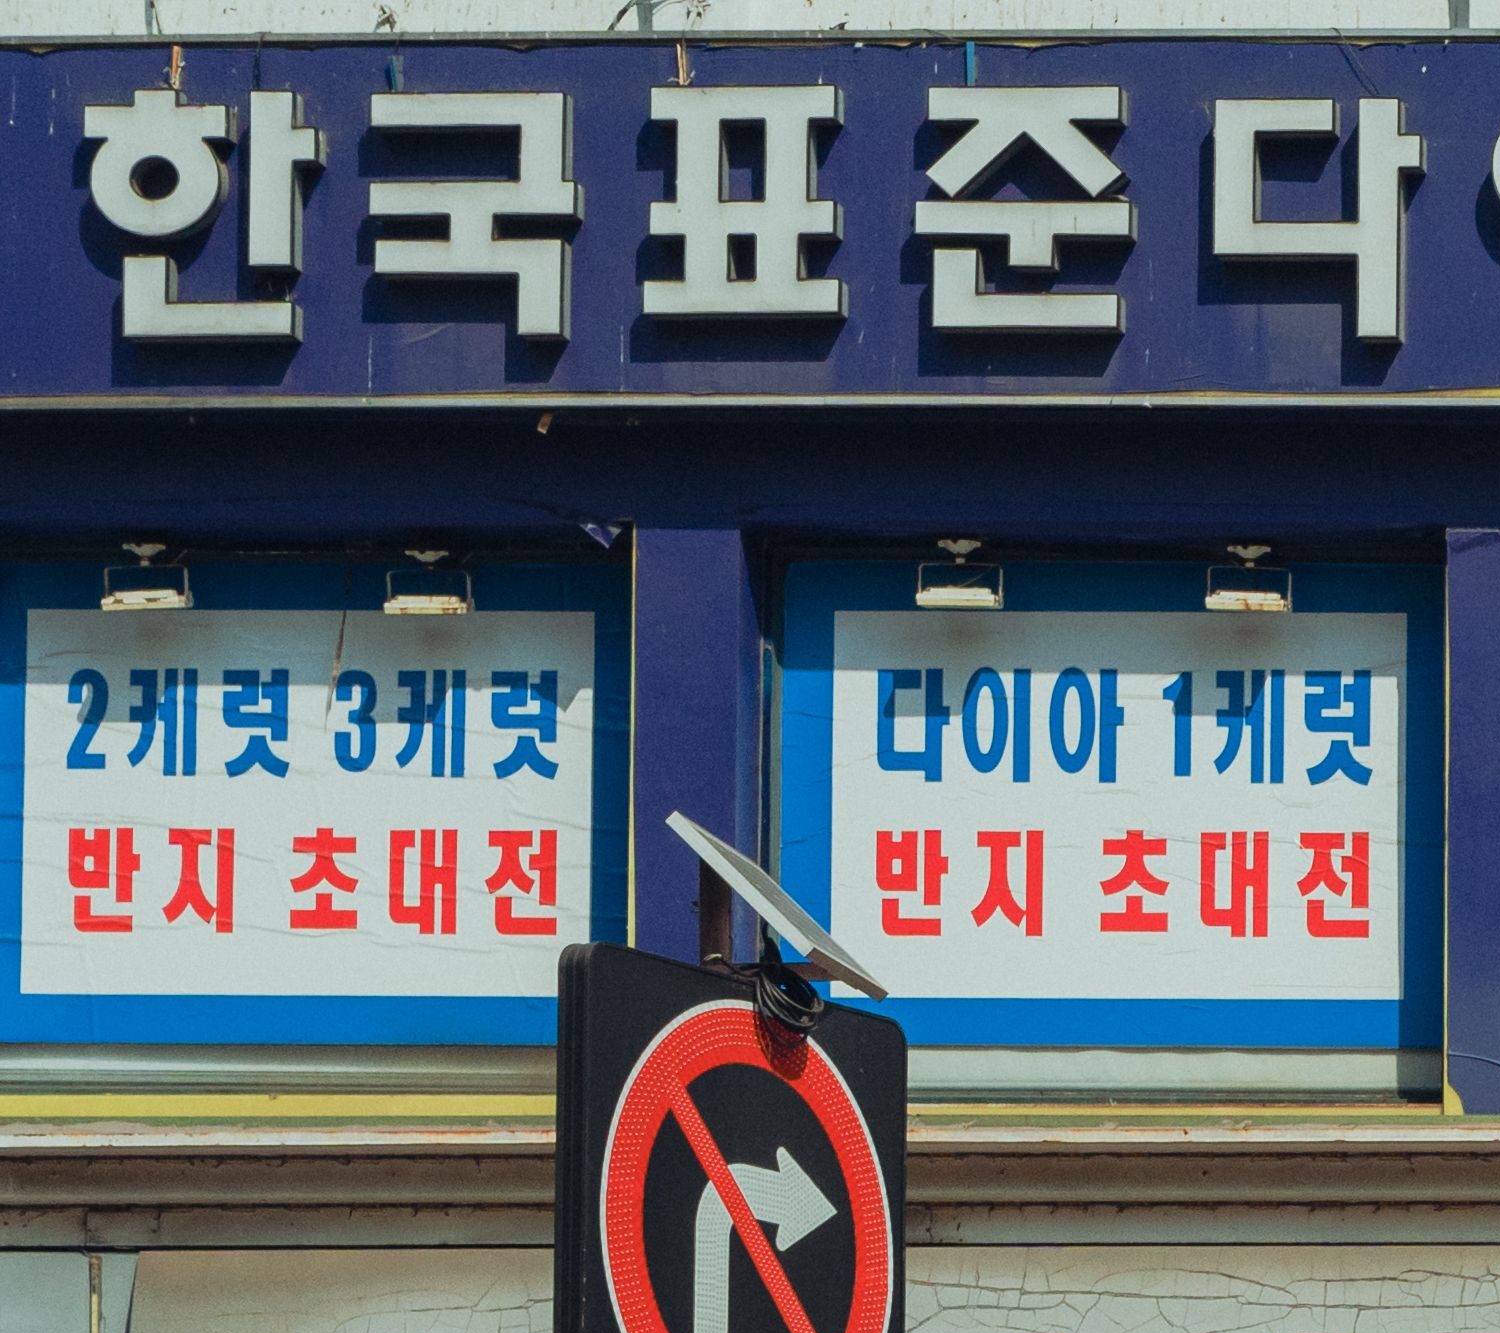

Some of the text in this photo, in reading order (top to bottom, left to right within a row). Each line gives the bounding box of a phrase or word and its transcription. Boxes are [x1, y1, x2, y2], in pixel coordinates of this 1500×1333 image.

[67, 667, 560, 780] 2케럿 3케럿
[878, 667, 1375, 787] 다이아 1케럿
[67, 827, 561, 936] 반지 초대전
[876, 828, 1372, 939] 반지 초대전
